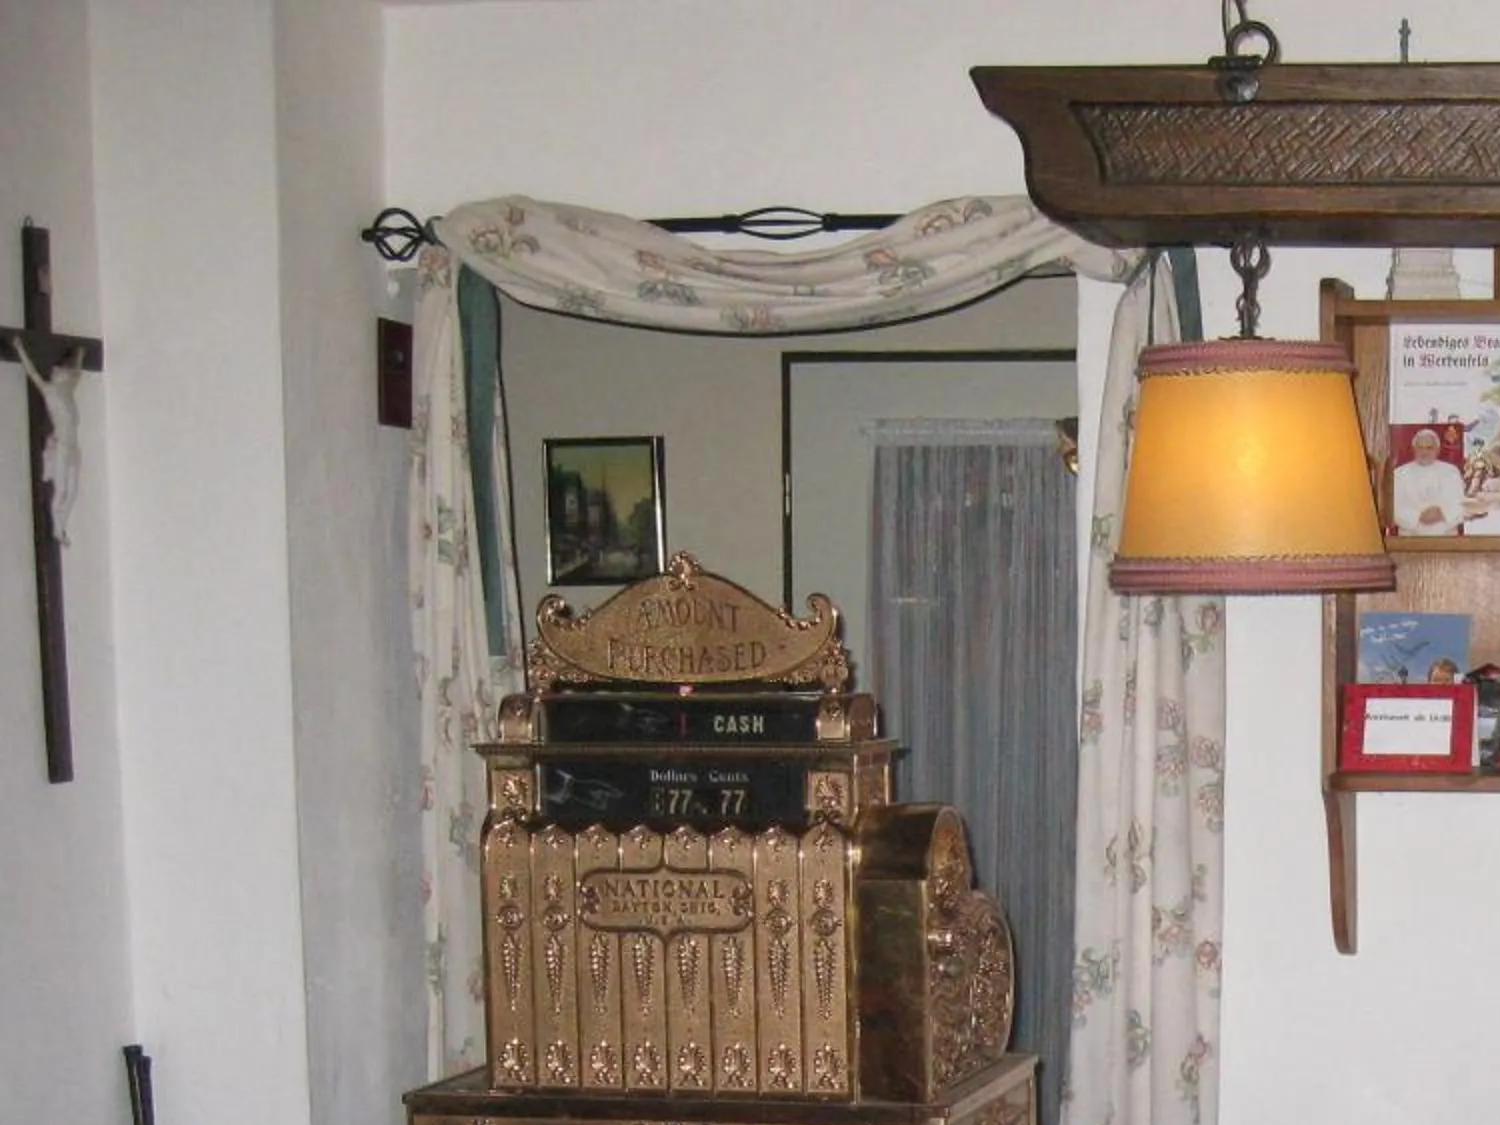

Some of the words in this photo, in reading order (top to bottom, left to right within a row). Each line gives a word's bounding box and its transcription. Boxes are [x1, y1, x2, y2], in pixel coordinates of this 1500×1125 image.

[1403, 355, 1415, 368] in
[638, 598, 741, 632] AMOUNT
[607, 638, 767, 674] PURCHASED
[713, 715, 764, 733] CASH
[651, 769, 698, 782] Dollars
[708, 769, 750, 783] Cents
[604, 879, 725, 899] NATIONAL
